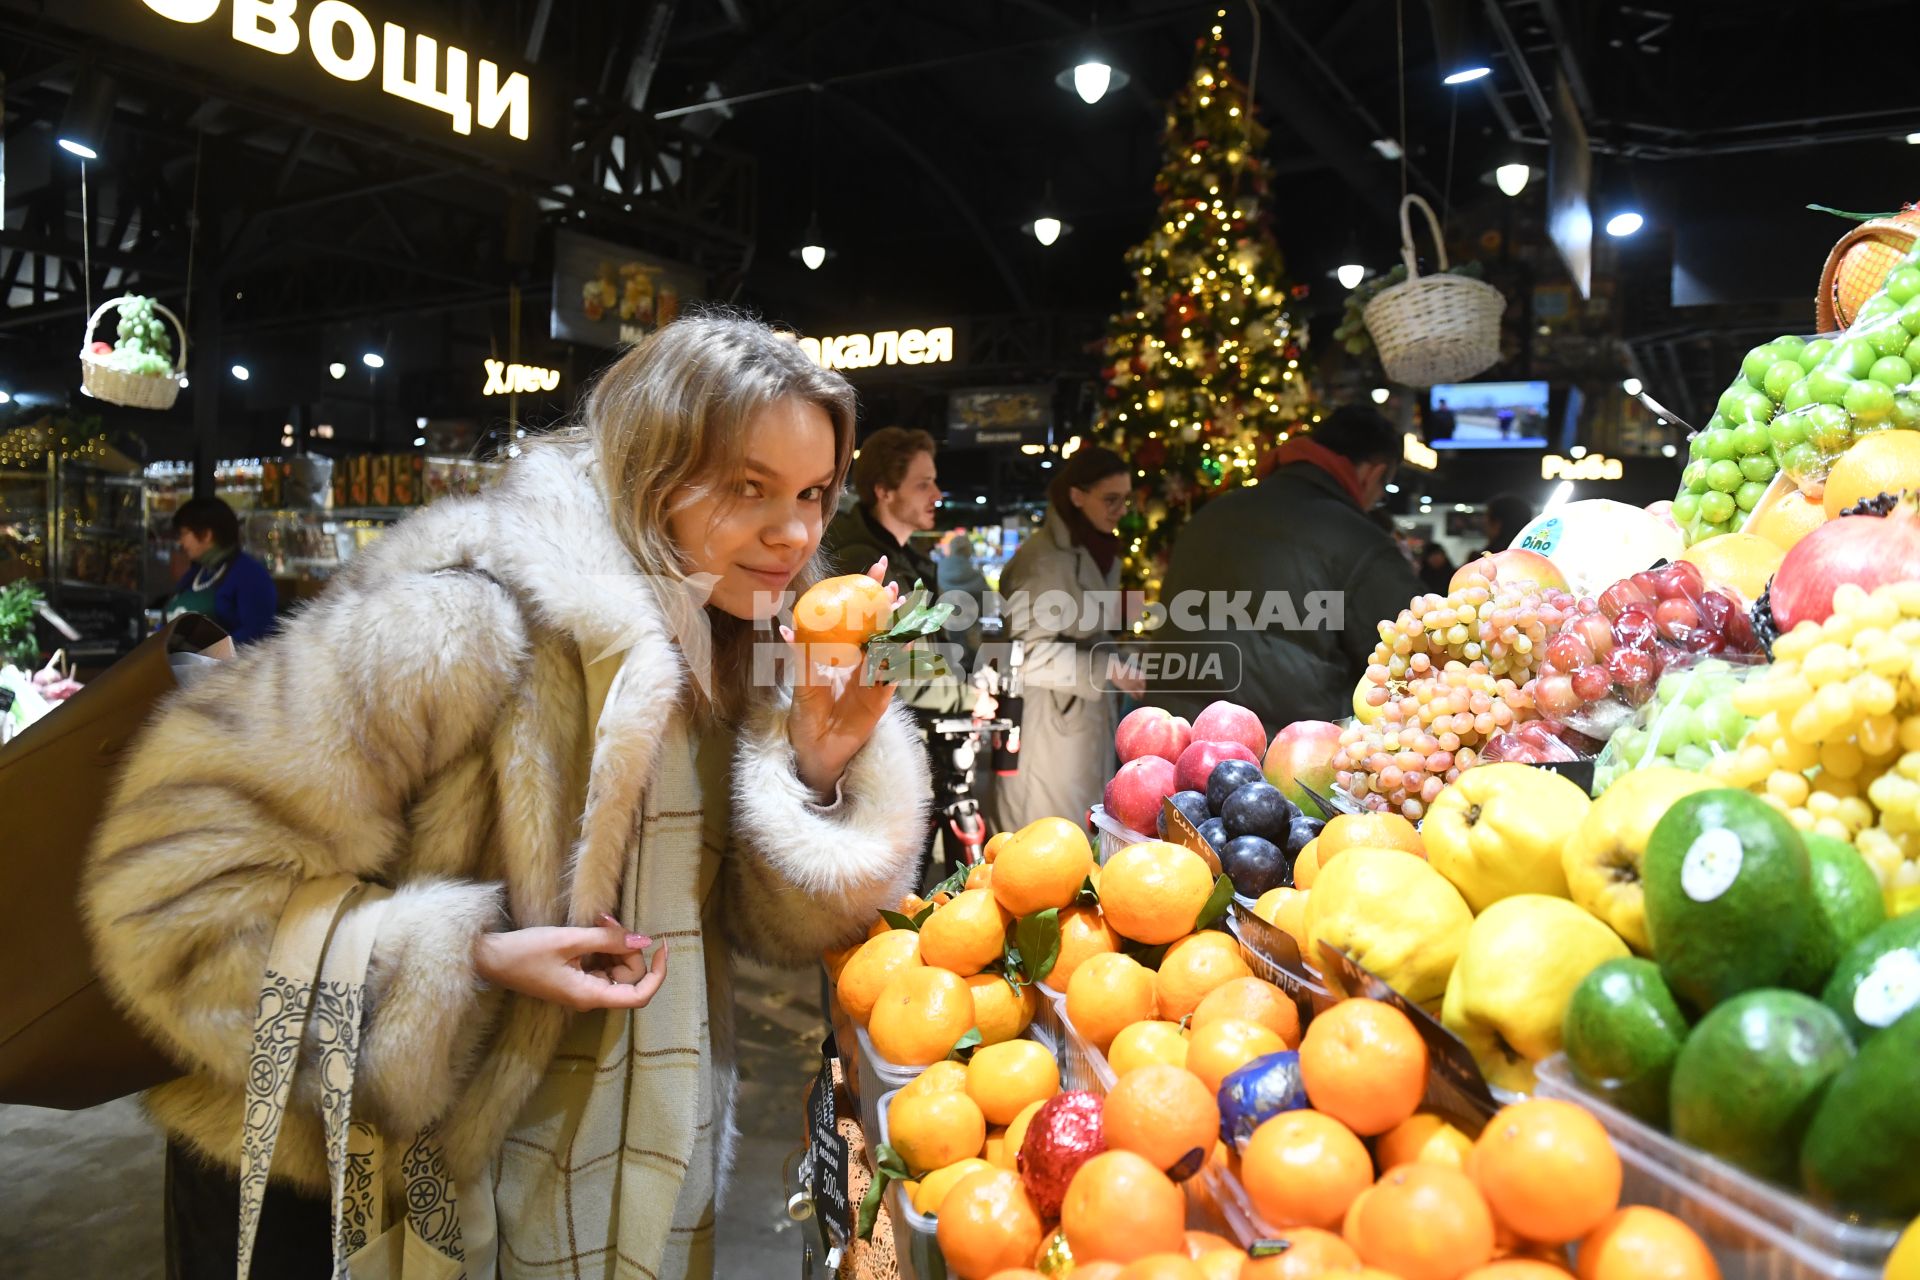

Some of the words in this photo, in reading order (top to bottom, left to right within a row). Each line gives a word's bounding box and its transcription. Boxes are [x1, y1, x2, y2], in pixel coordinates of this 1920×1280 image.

[140, 0, 530, 141] вощи
[772, 326, 953, 370] акалея
[1521, 536, 1551, 551] Dino
[822, 1167, 837, 1199] 500
